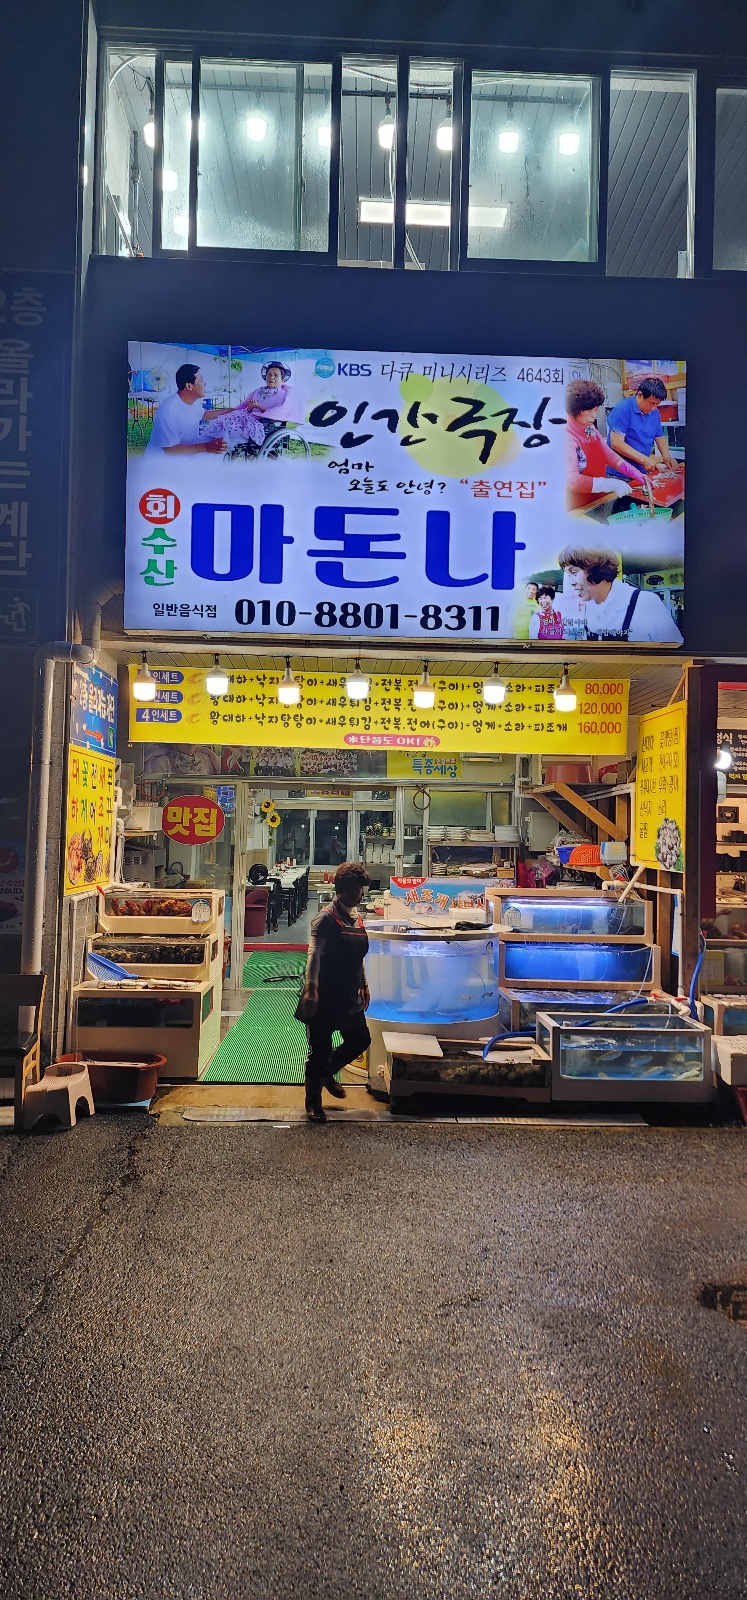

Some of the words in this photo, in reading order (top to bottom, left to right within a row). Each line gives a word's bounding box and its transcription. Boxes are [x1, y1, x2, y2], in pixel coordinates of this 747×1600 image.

[0, 287, 47, 326] 층
[338, 363, 371, 376] KBS
[381, 361, 414, 382] 다큐
[423, 363, 507, 385] 미니시리즈
[517, 367, 564, 385] 4643회
[309, 396, 568, 464] 인간극장
[328, 458, 374, 474] 엄마
[348, 477, 389, 494] 오늘도
[396, 479, 446, 495] 안녕?
[145, 494, 175, 519] 회
[190, 502, 527, 590] 마돈나
[140, 528, 178, 587] 수산
[153, 603, 217, 618] 일반음식점
[235, 599, 501, 631] 010-8801-8311
[144, 671, 180, 684] 인세트
[585, 683, 624, 696] 80,000
[578, 702, 623, 716] 120,000
[577, 722, 622, 735] 160,000
[412, 759, 458, 778] 특종세상
[167, 807, 217, 836] 맛집
[406, 889, 449, 909] 새조개
